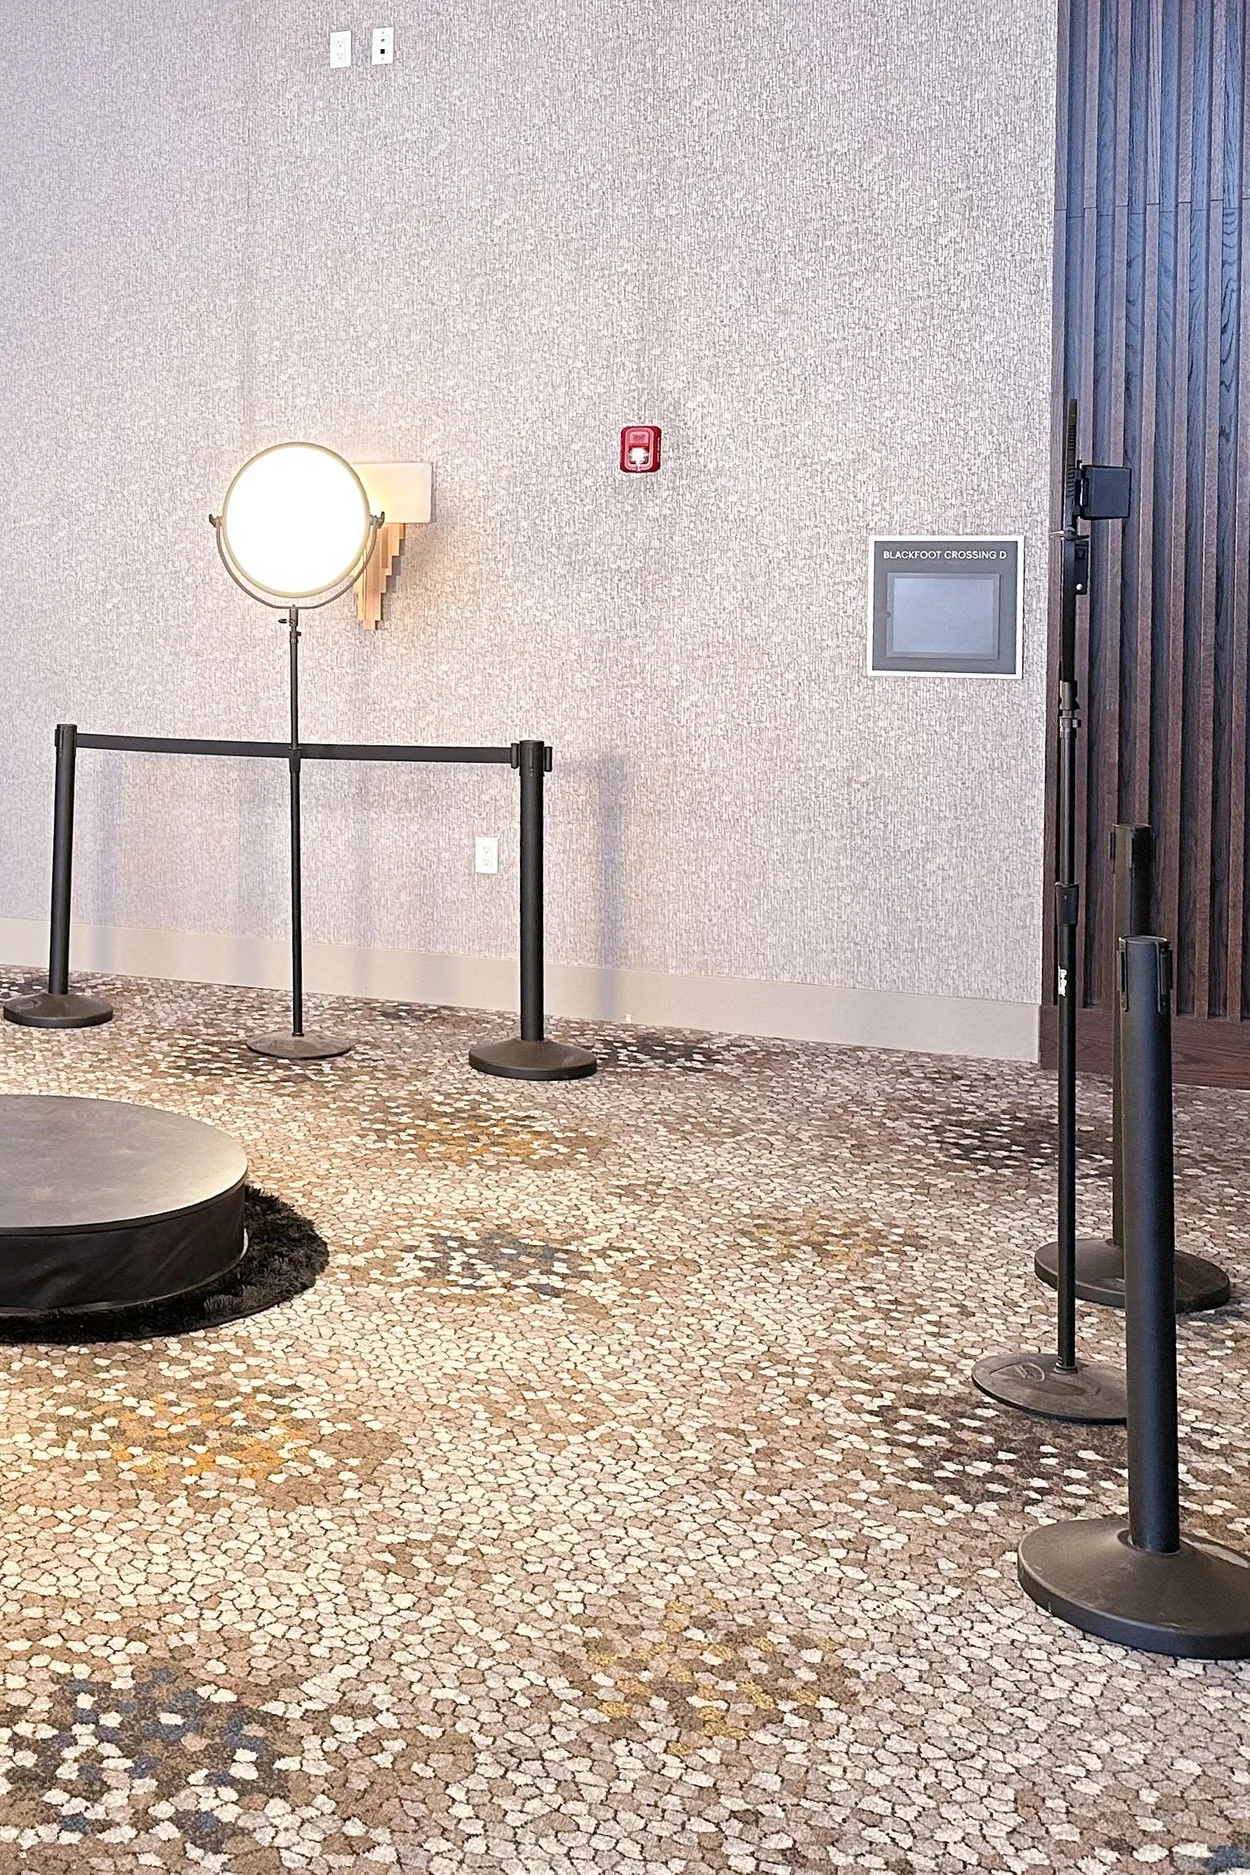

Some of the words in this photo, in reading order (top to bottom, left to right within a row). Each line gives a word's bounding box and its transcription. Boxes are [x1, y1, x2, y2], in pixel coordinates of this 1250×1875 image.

[883, 550, 942, 559] BLACKFOOT
[943, 550, 997, 560] CROSSING
[999, 550, 1007, 559] D
